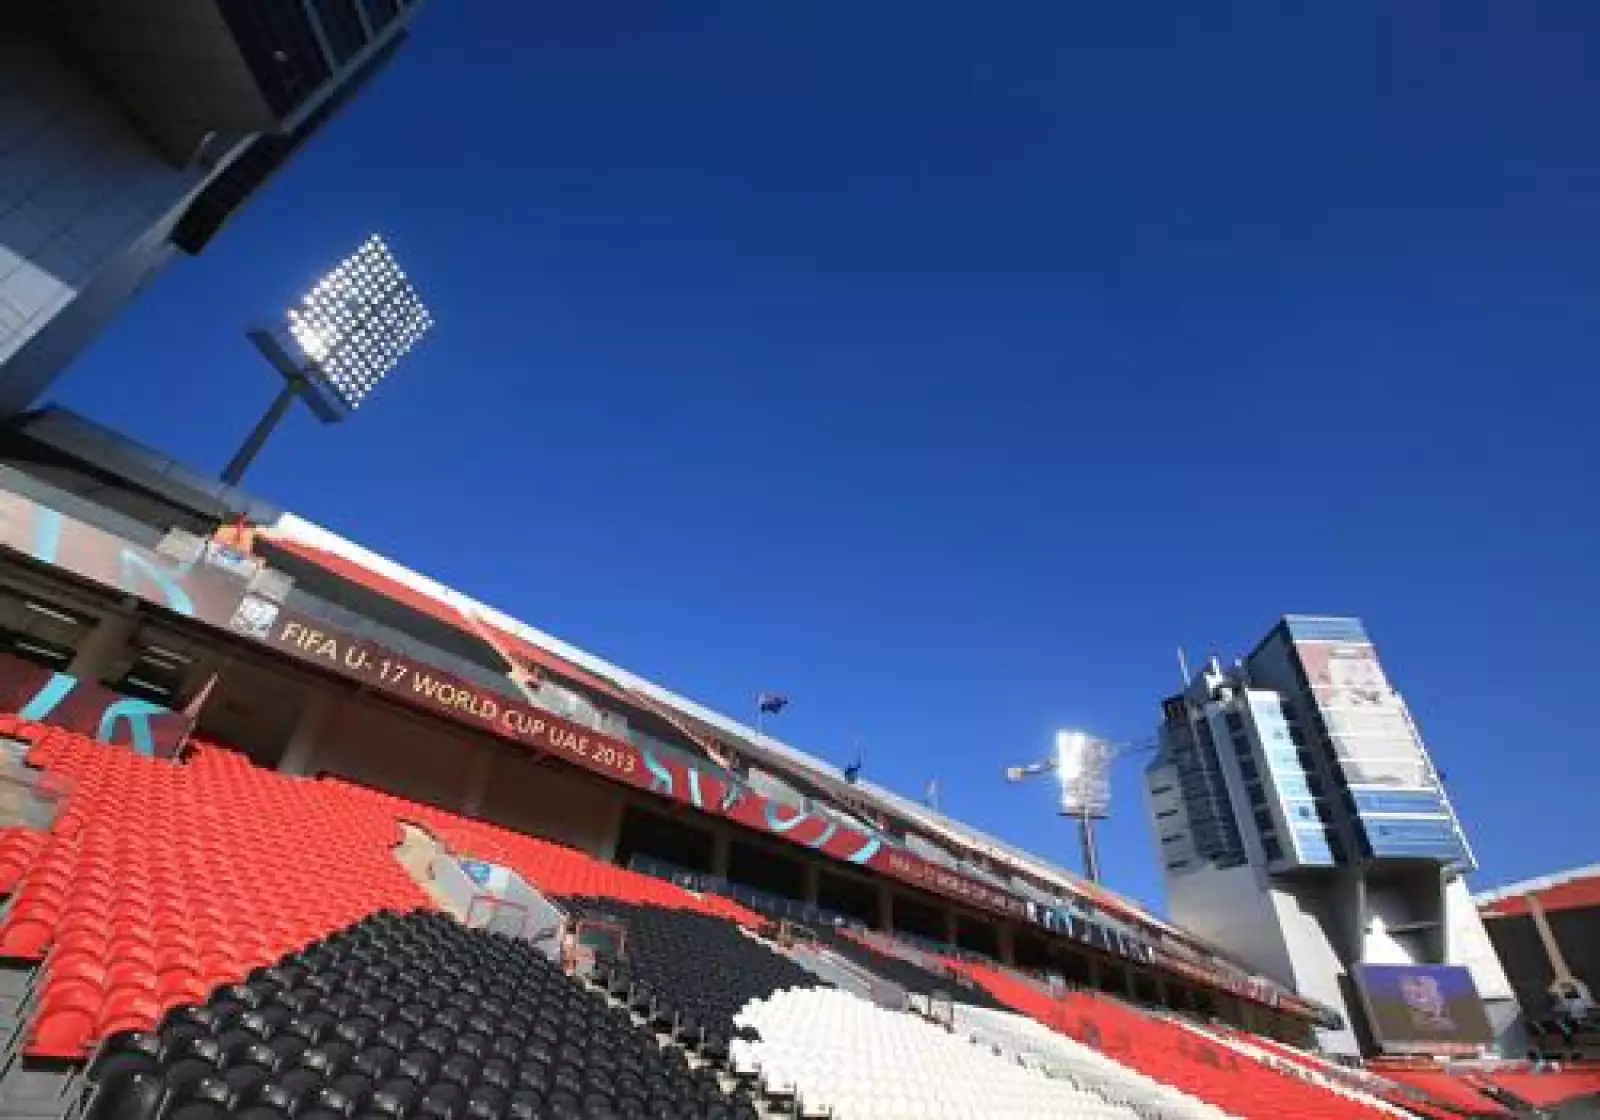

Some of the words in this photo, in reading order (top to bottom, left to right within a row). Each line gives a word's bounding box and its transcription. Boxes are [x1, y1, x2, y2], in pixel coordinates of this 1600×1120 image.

[281, 623, 337, 660] FIFA
[412, 671, 498, 719] WORLD
[502, 709, 545, 737] CUP
[549, 726, 590, 756] UAE
[592, 742, 637, 773] 2013
